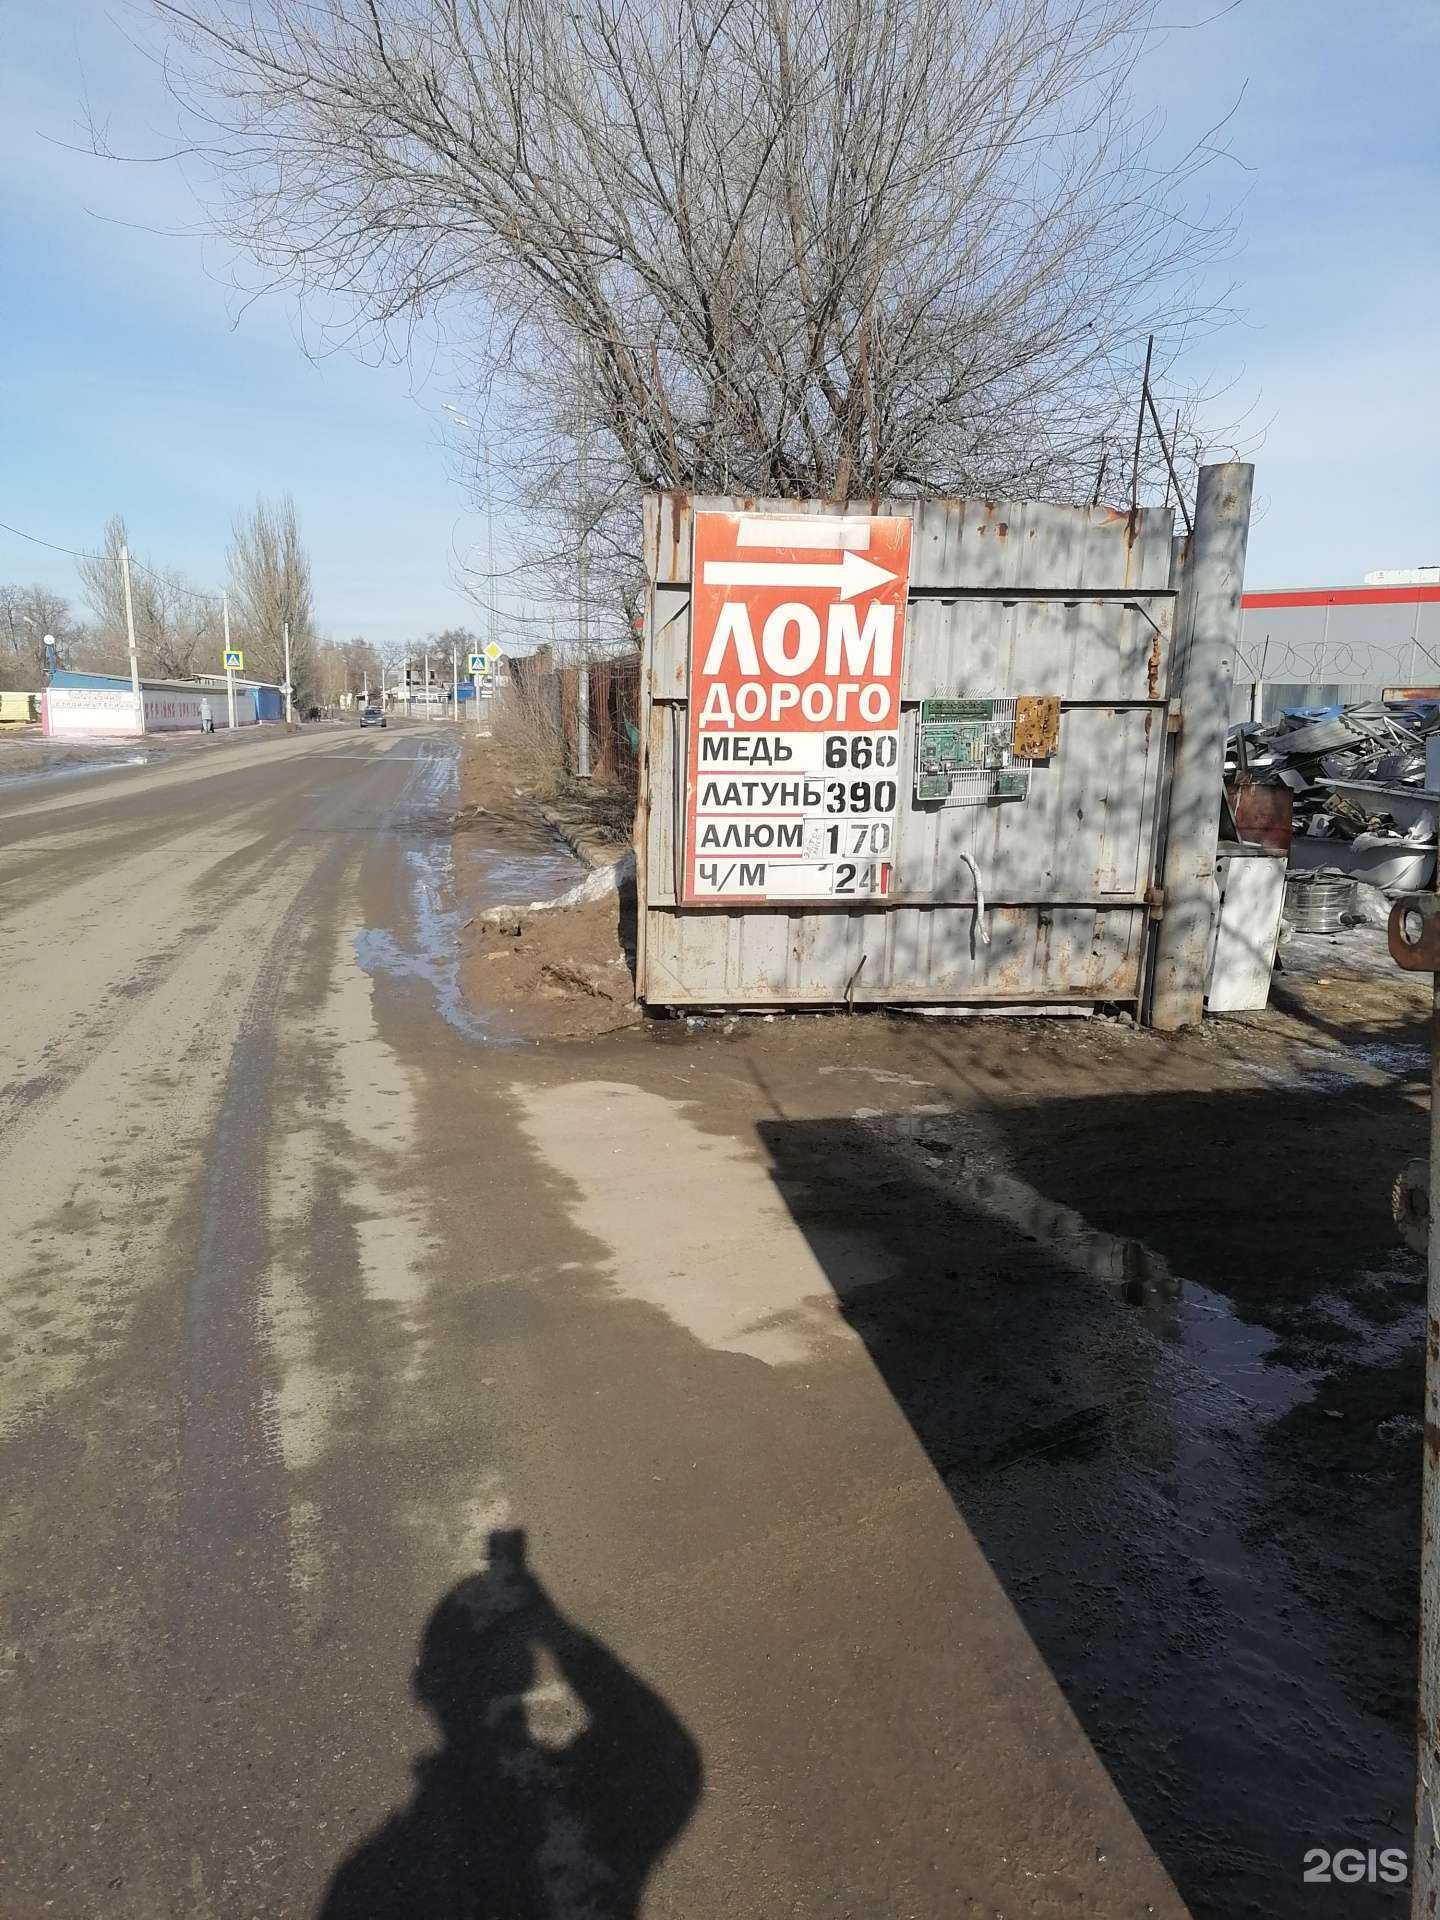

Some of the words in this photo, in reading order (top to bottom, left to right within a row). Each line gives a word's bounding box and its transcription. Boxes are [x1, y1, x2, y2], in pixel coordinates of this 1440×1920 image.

[702, 601, 895, 677] ЛОМ
[698, 682, 891, 729] ДОРОГО
[702, 736, 793, 766] МЕДЬ
[825, 735, 898, 770] 660
[701, 782, 822, 807] ЛАТУНЬ
[826, 780, 897, 814] 390
[700, 824, 803, 848] АЛЮМ
[826, 822, 890, 855] 170
[699, 863, 766, 892] Ч/М
